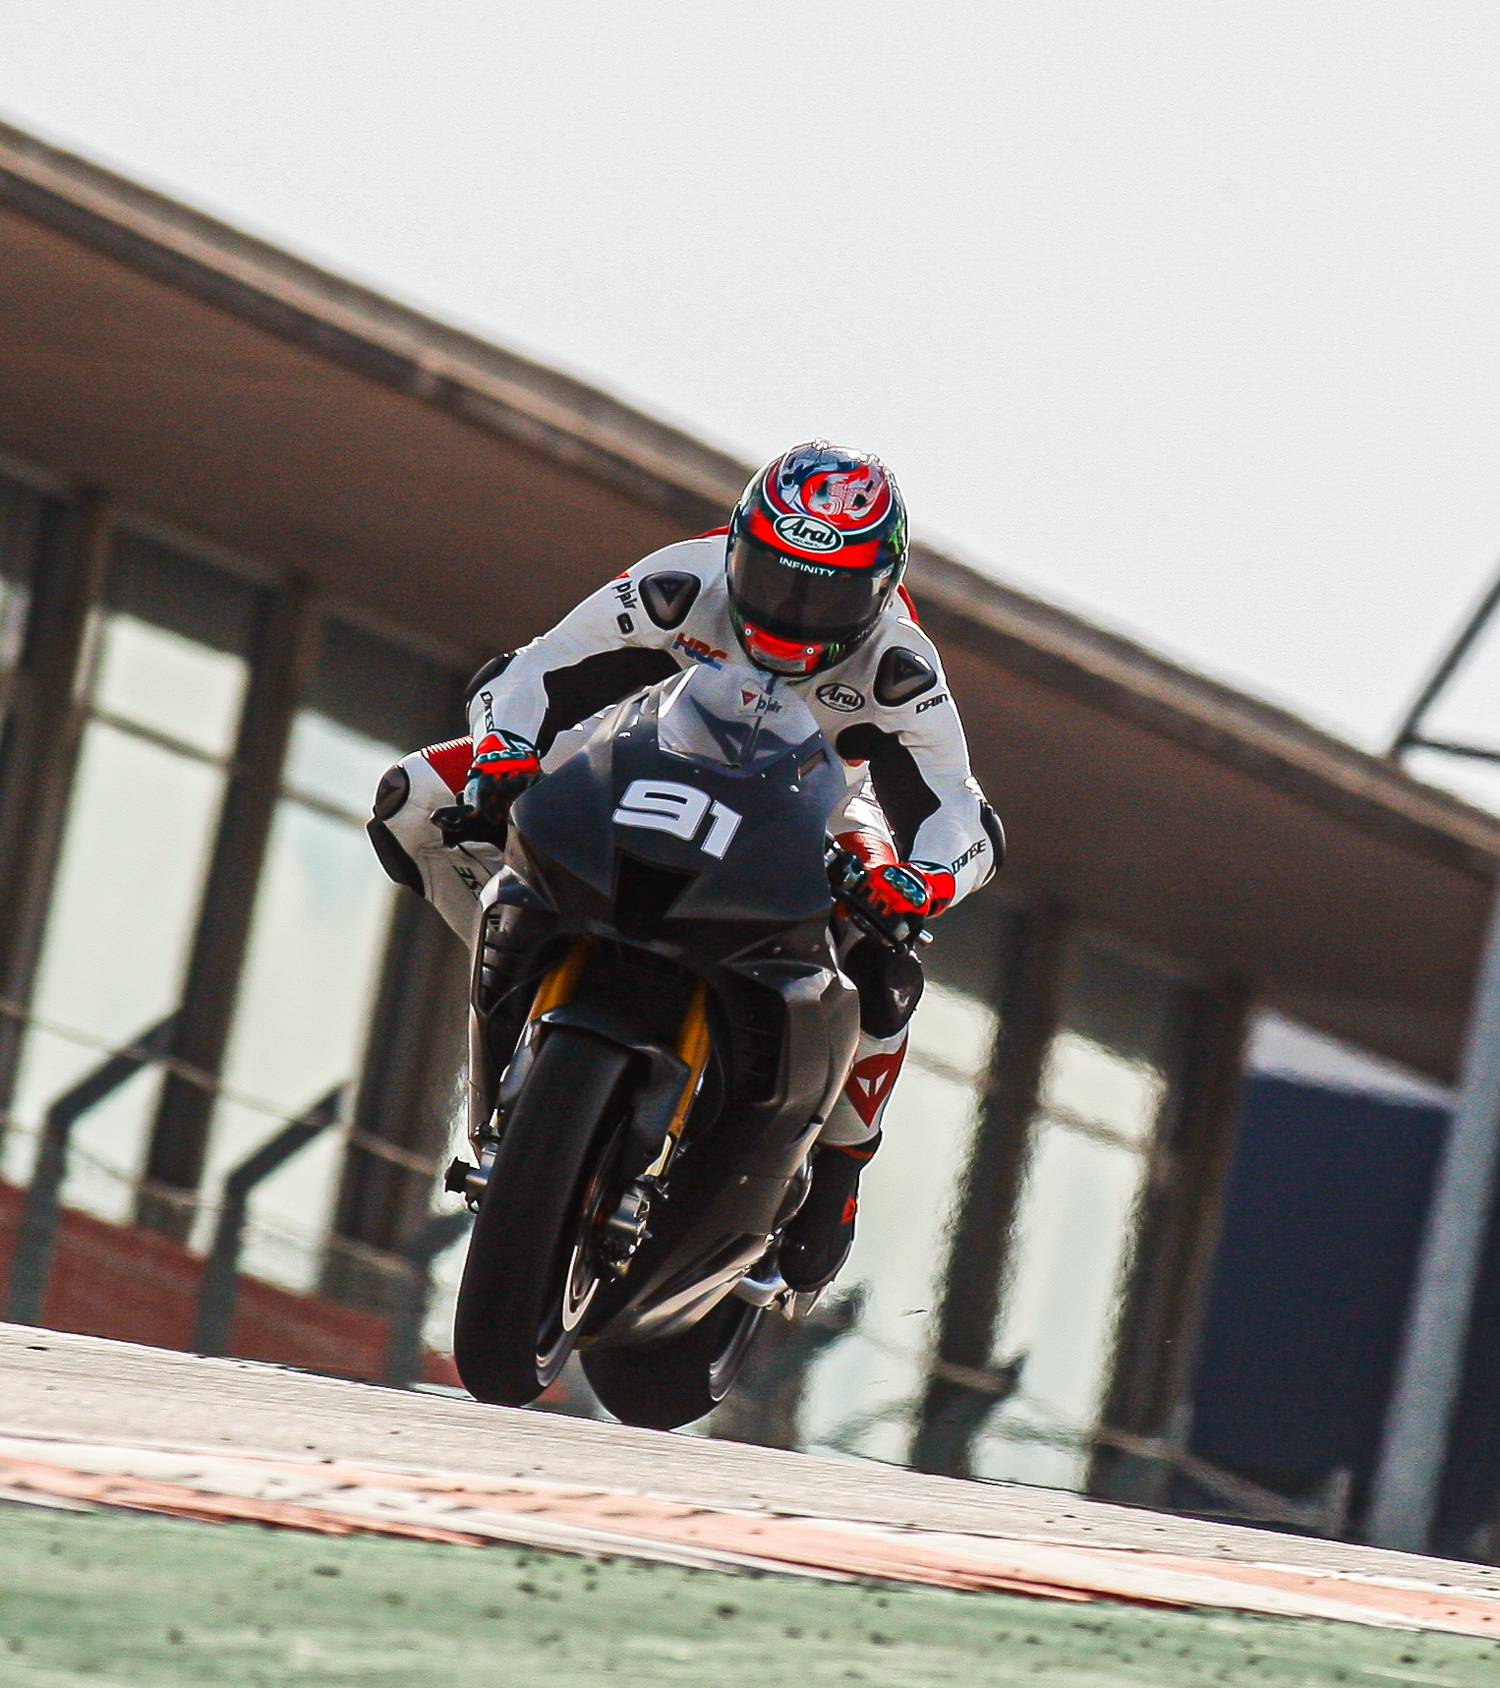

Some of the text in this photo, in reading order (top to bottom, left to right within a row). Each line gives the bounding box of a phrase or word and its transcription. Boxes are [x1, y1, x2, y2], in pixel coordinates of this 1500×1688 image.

[779, 518, 833, 546] Arai
[779, 556, 836, 577] INFINITY
[672, 631, 728, 671] HRC
[826, 685, 861, 707] Arai
[612, 779, 742, 860] 91
